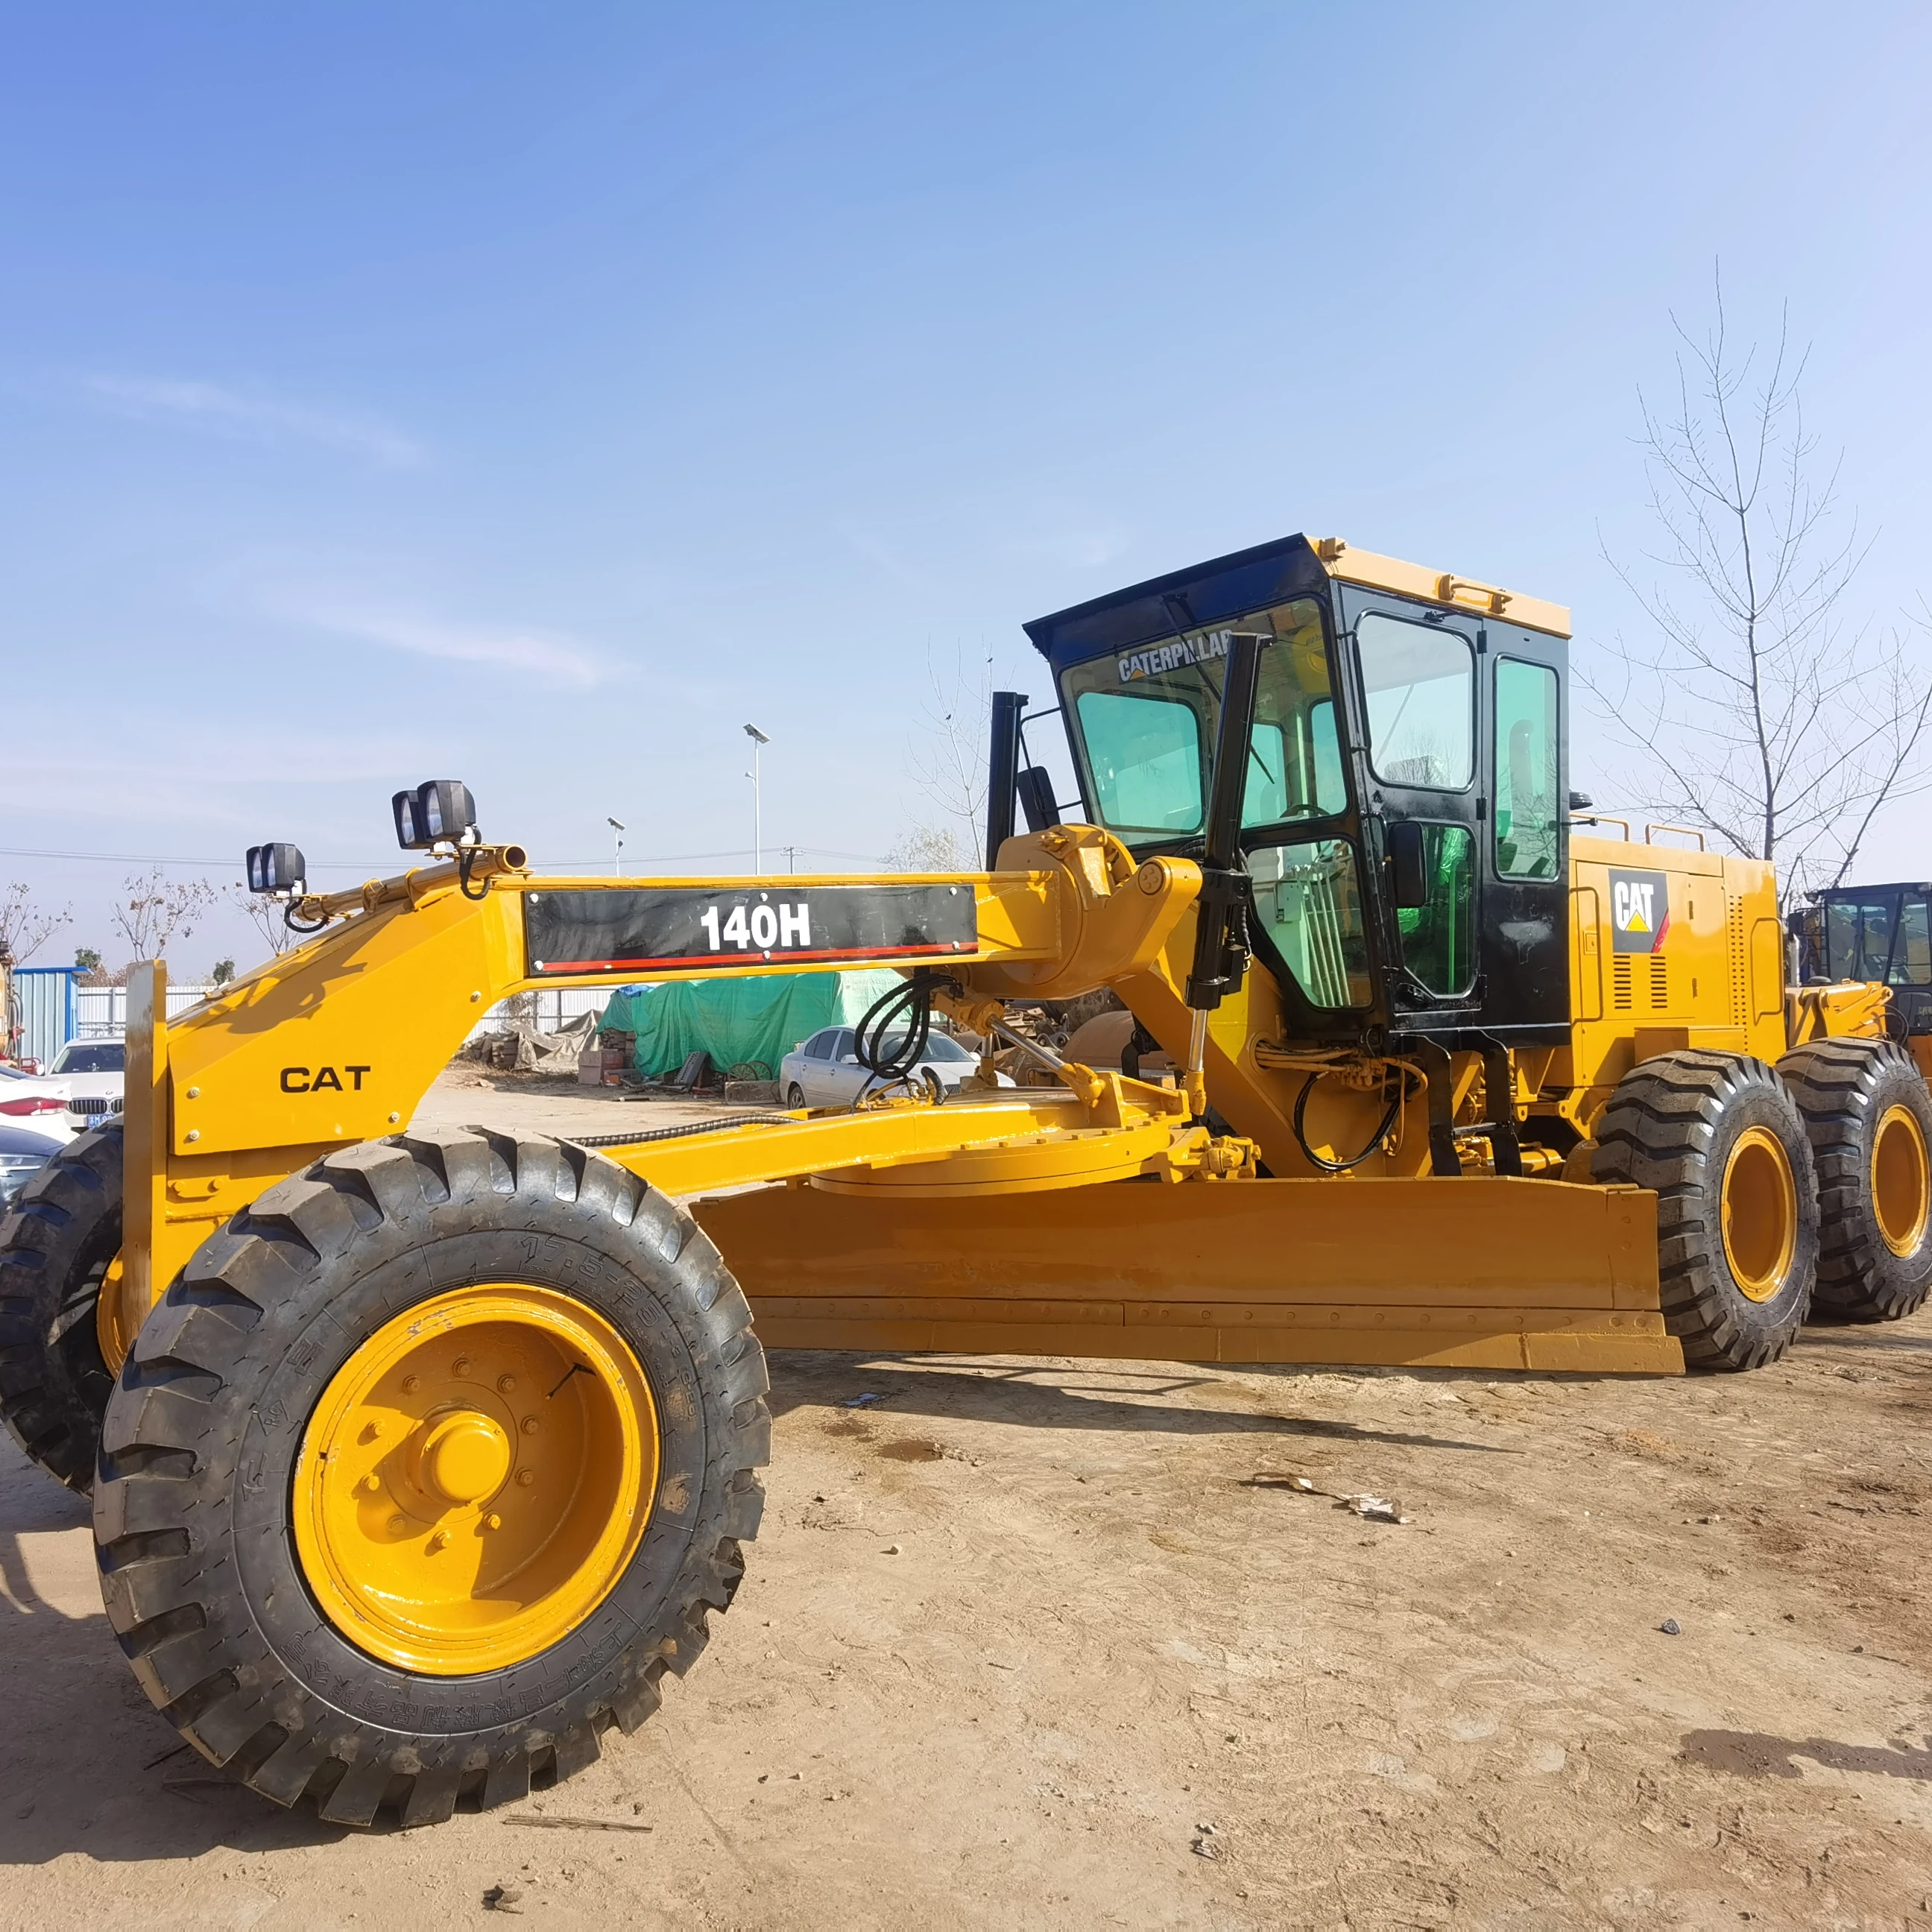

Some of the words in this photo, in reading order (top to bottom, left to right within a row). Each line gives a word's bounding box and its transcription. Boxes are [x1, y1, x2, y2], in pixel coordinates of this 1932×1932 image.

[701, 903, 811, 950] 140H
[1614, 881, 1654, 932] CAT
[280, 1066, 370, 1093] CAT
[521, 1236, 663, 1328] 17.5-25
